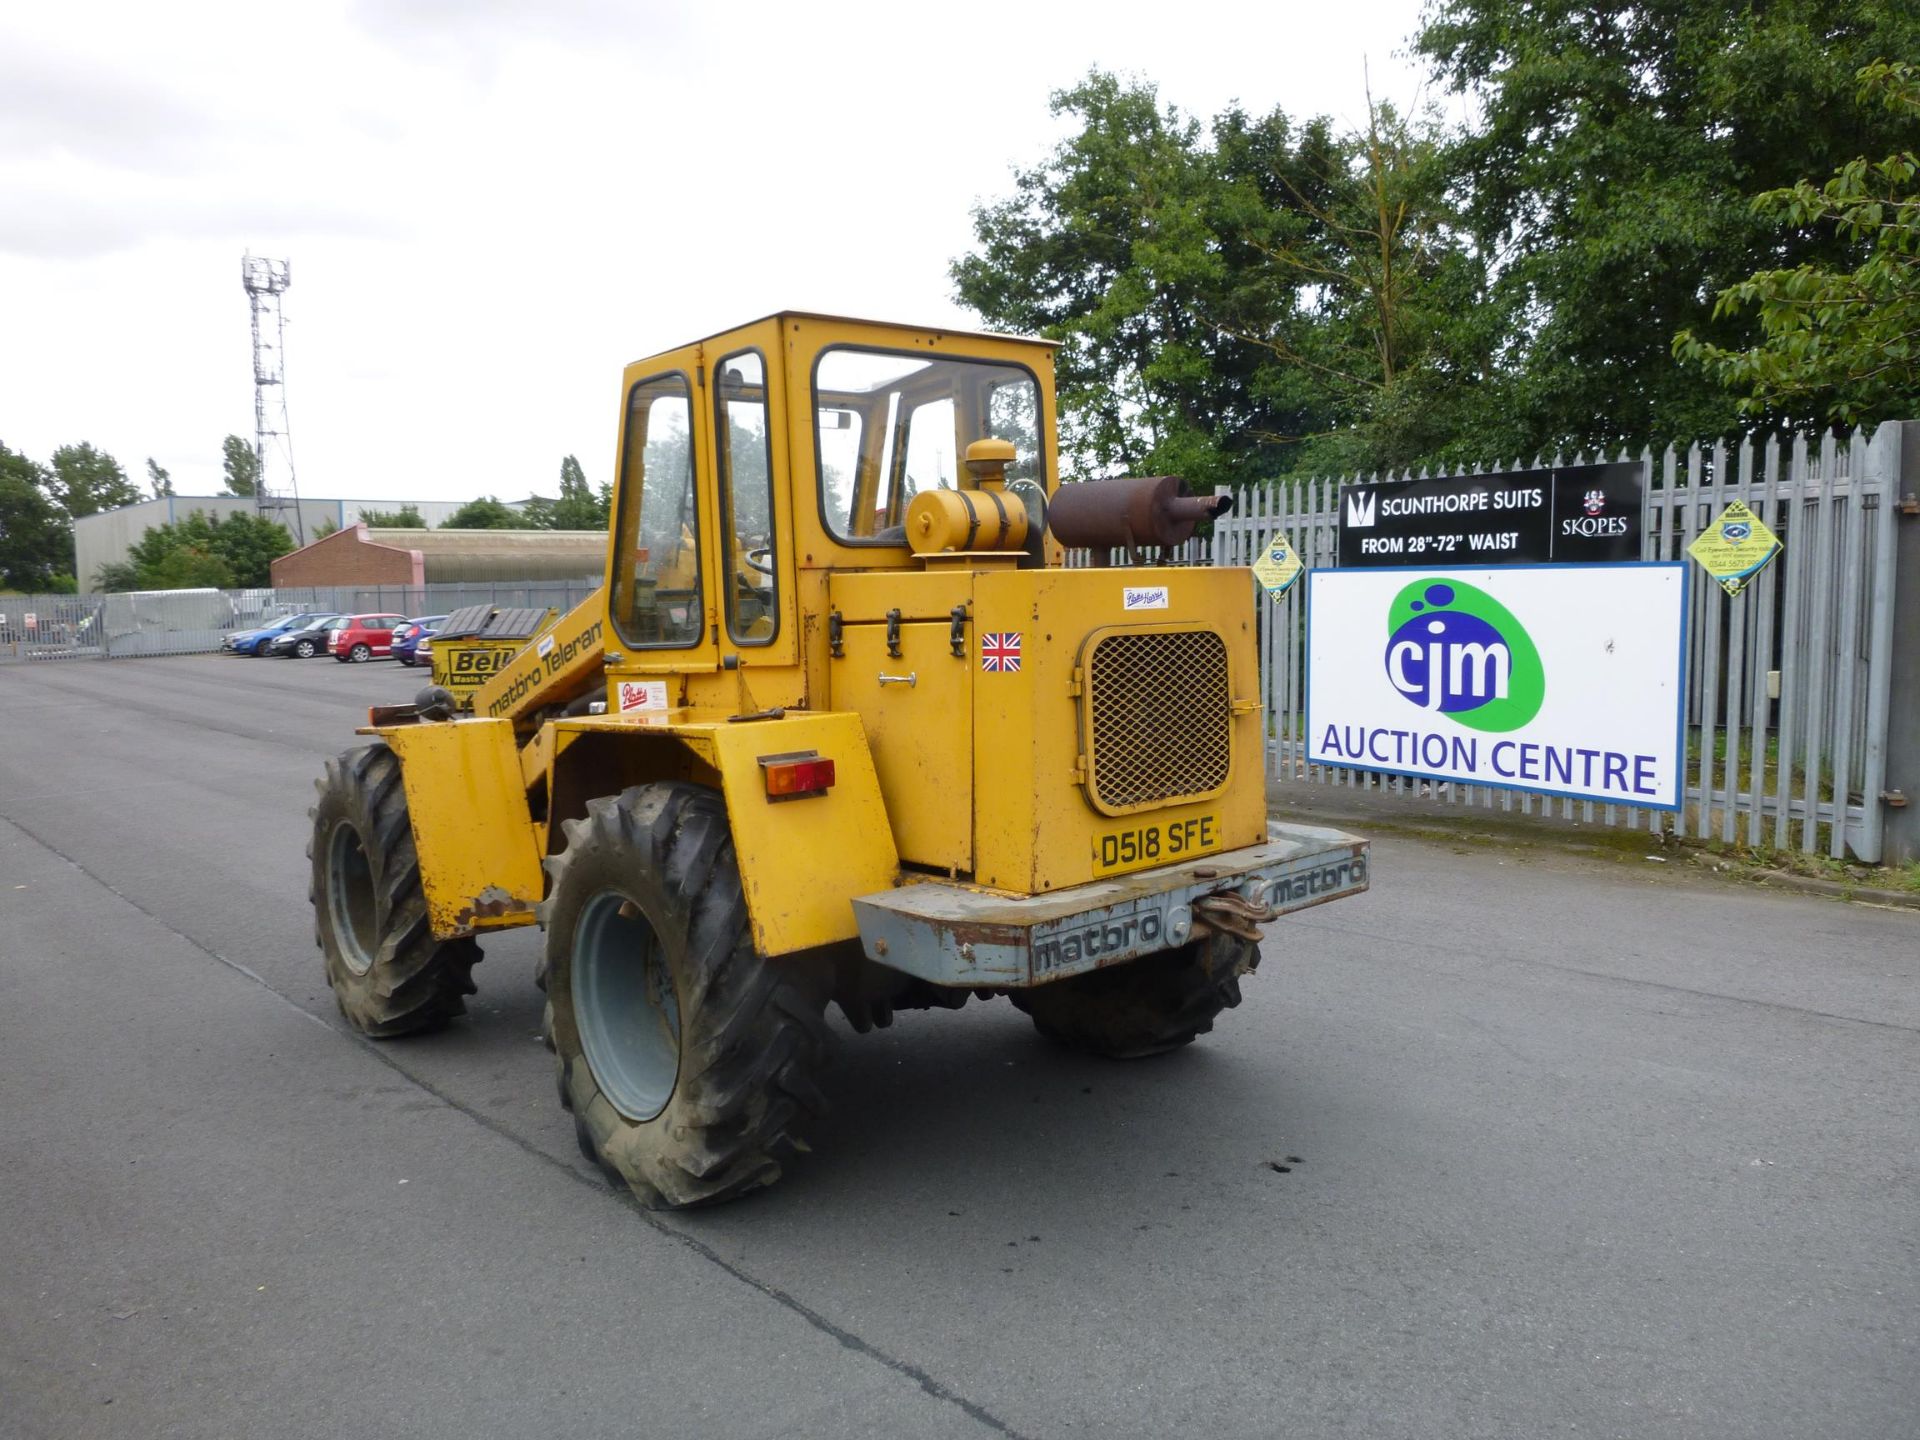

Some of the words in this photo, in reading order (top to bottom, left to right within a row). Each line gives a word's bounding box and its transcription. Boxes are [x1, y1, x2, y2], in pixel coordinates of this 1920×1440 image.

[1382, 491, 1488, 516] SCUNTHORPE
[1493, 489, 1542, 510] SUITS
[1562, 517, 1627, 537] SKOPES
[1362, 537, 1403, 554] FROM
[1469, 532, 1518, 550] WAIST
[1389, 620, 1509, 712] cjm
[489, 667, 541, 718] matbro
[1321, 724, 1477, 773] AUCTION
[1491, 741, 1656, 796] CENTRE
[1102, 827, 1160, 867] D518
[1168, 816, 1213, 853] SFE
[1272, 860, 1364, 905] matbro
[1034, 914, 1160, 972] matbro
